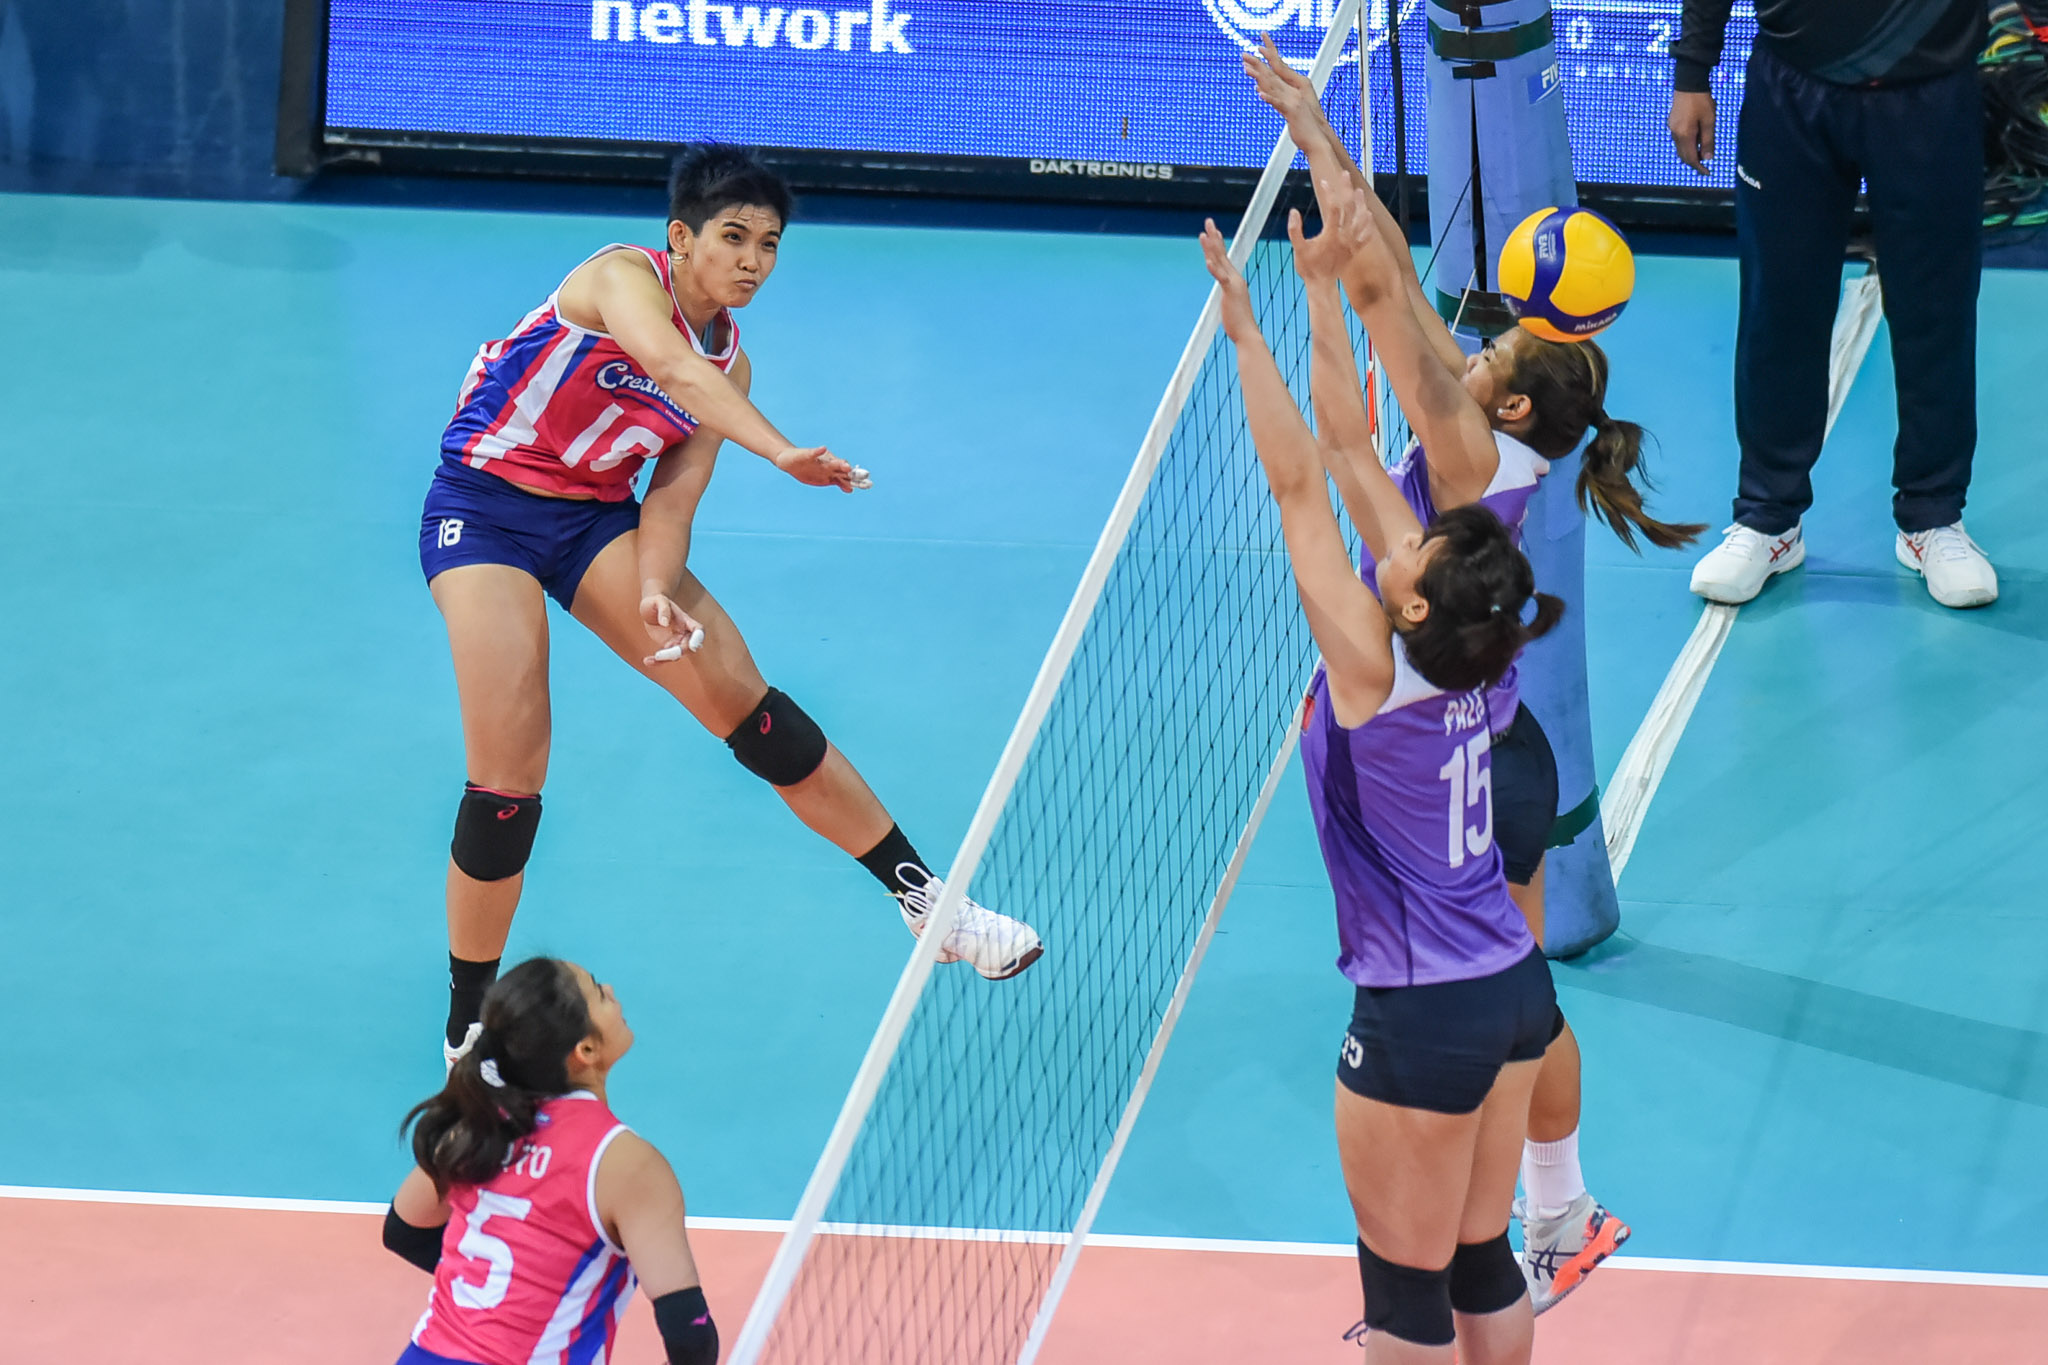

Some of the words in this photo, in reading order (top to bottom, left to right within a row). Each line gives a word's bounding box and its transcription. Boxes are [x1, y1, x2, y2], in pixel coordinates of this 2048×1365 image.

[591, 0, 913, 54] network
[1029, 159, 1174, 180] DAKTRONICS
[438, 518, 465, 549] 18
[1439, 725, 1493, 868] 15
[451, 1188, 532, 1309] 5
